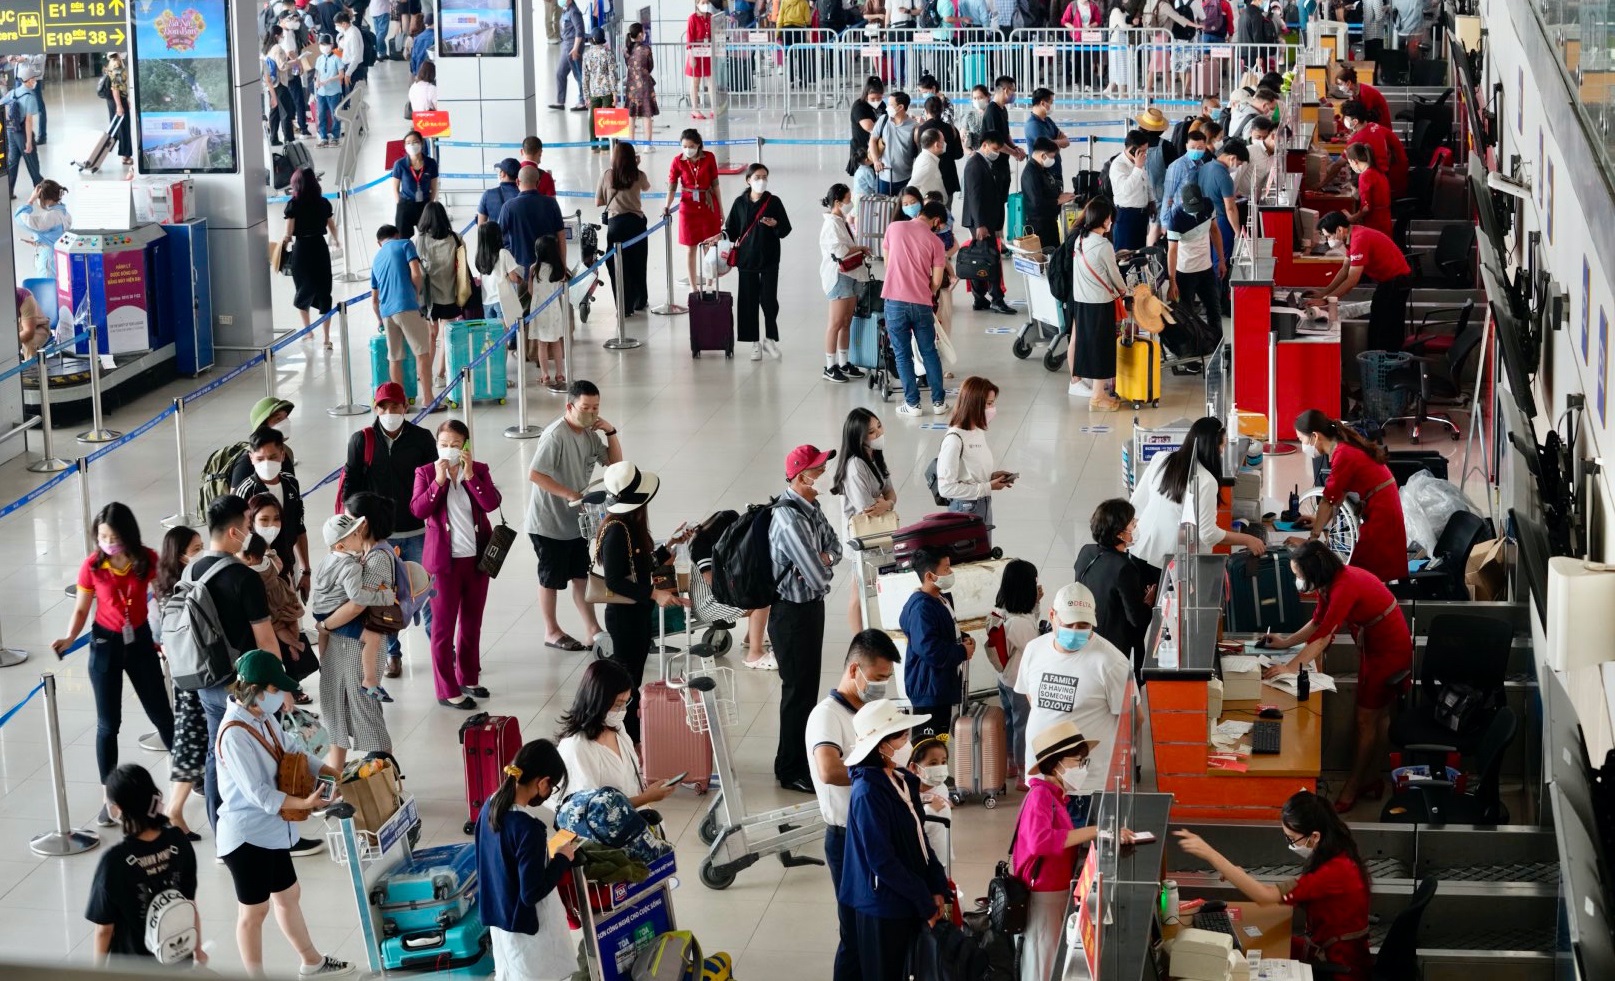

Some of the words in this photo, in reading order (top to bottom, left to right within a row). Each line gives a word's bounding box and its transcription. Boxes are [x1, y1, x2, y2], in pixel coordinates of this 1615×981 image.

[49, 3, 67, 17] E1
[88, 2, 105, 16] 18
[46, 32, 73, 46] E19
[88, 31, 107, 45] 38
[1073, 600, 1092, 608] DELTA
[1043, 674, 1050, 682] A
[1049, 674, 1077, 685] FAMILY
[1048, 684, 1075, 694] HAVING
[1040, 690, 1073, 701] SOMEONE
[1039, 699, 1051, 708] TO
[1050, 700, 1072, 712] LOVE
[615, 886, 626, 897] TOA
[630, 910, 640, 922] CHO
[638, 926, 650, 937] TOA
[617, 938, 630, 950] TOA
